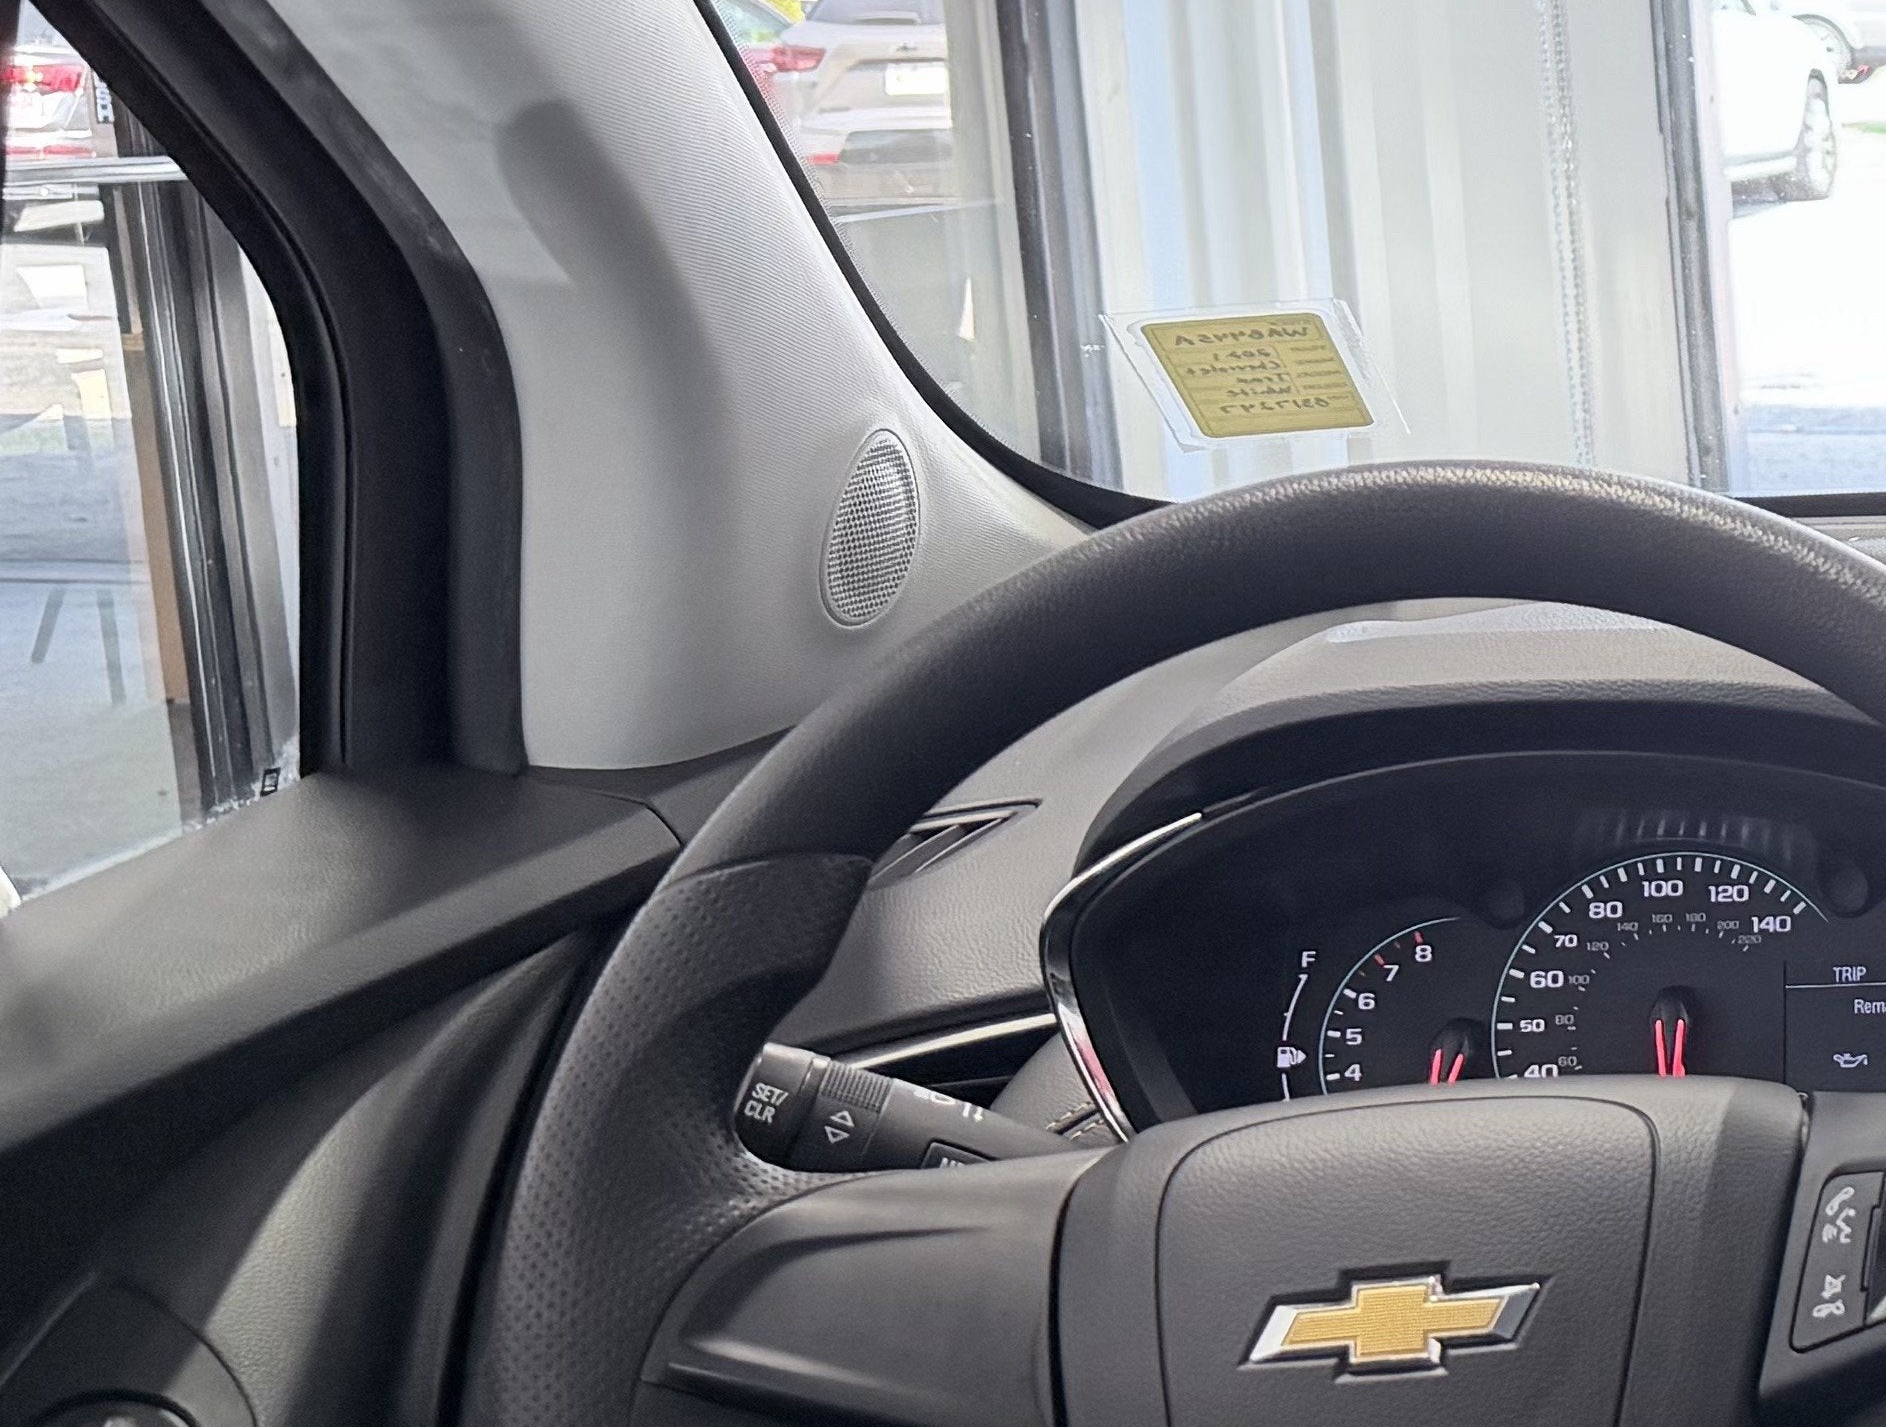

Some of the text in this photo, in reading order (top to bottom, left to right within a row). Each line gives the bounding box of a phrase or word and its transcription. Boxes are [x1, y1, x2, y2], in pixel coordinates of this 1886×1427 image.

[1642, 880, 1684, 897] 100
[1709, 885, 1749, 903] 120
[1588, 901, 1622, 919] 80
[1617, 922, 1638, 931] 140
[1652, 914, 1672, 923] 160
[1717, 921, 1739, 930] 200
[1752, 916, 1791, 933] 140
[1554, 935, 1578, 947] 70
[1586, 942, 1608, 951] 120
[1302, 951, 1316, 967] F
[1414, 943, 1433, 963] 8
[1384, 965, 1399, 981] 7
[1530, 971, 1564, 988] 60
[1568, 975, 1590, 985] 100
[1833, 966, 1867, 983] TRIP
[1358, 993, 1375, 1009] 6
[1520, 1019, 1545, 1032] 50
[1555, 1015, 1574, 1025] 80
[1346, 1029, 1362, 1045] 5
[1558, 1056, 1577, 1067] 60
[1344, 1064, 1362, 1081] 4
[1524, 1064, 1558, 1078] 40
[751, 1082, 789, 1106] SET/
[744, 1100, 777, 1124] CLR
